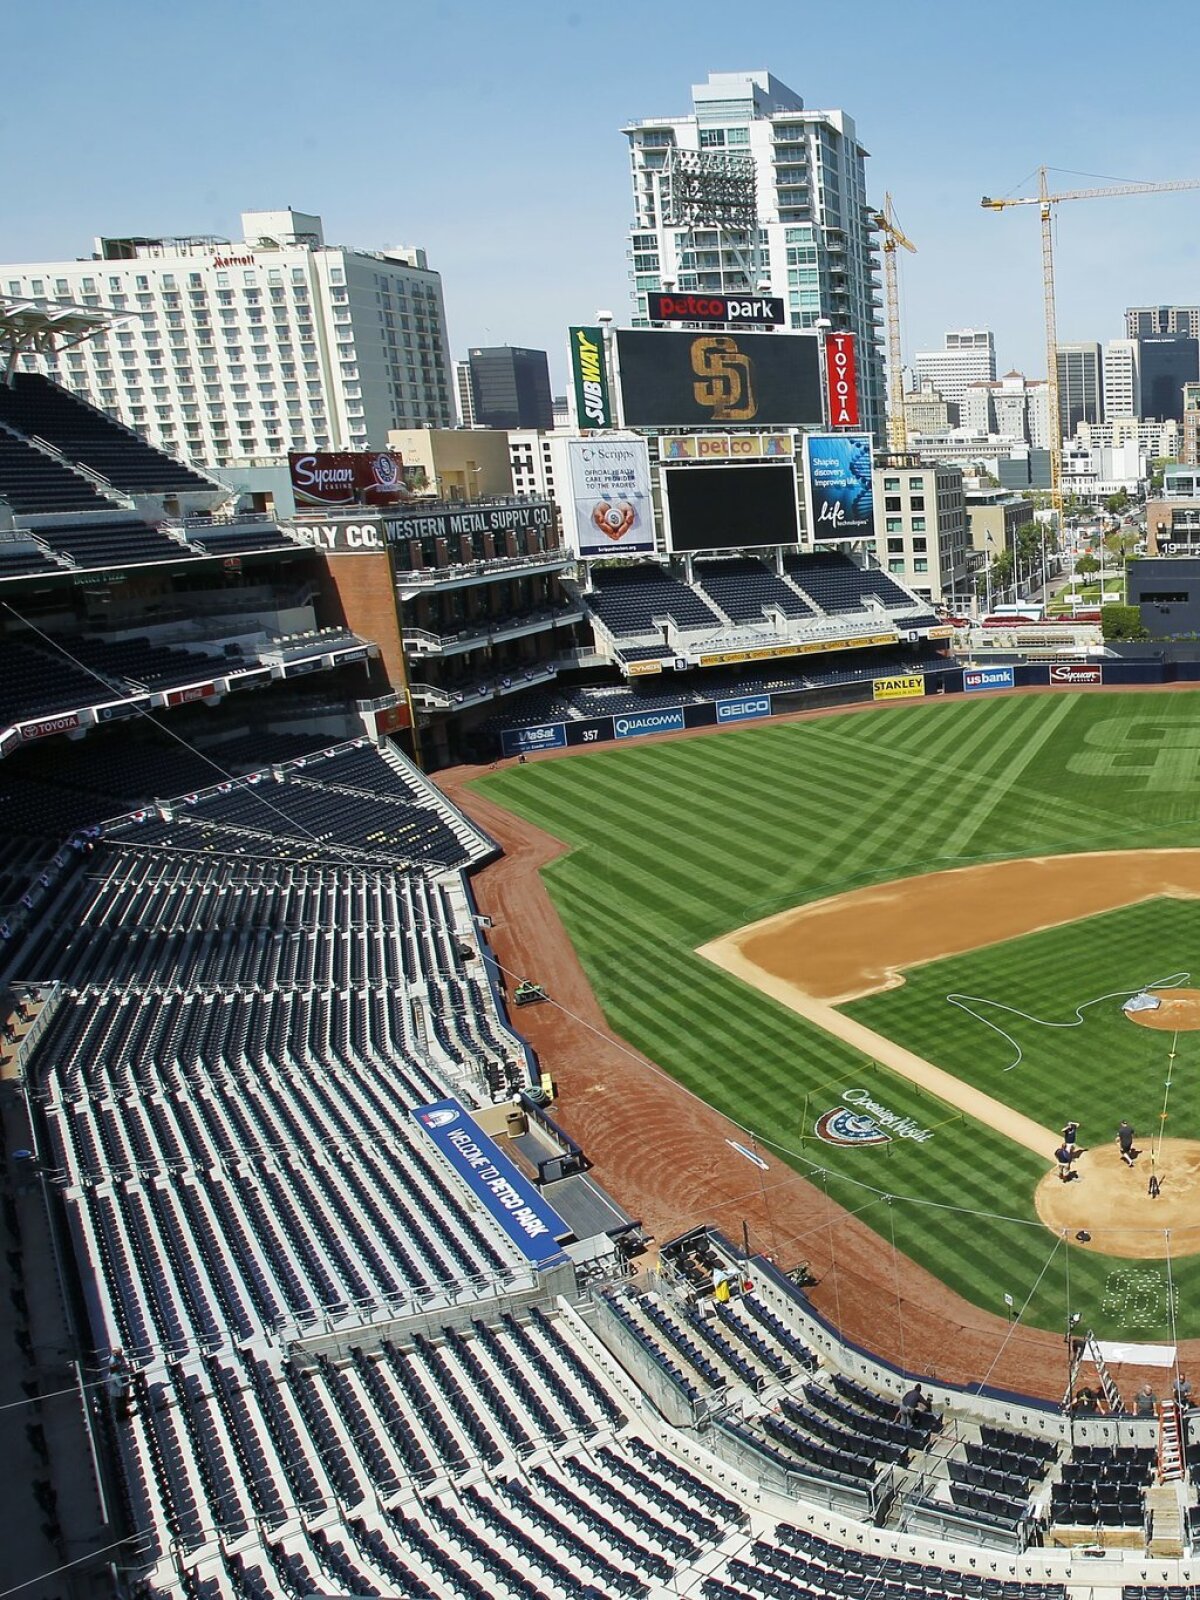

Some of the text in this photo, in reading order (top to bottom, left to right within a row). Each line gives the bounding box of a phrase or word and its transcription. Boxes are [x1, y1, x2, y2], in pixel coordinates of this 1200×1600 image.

[213, 255, 255, 268] Marriott
[659, 297, 774, 321] petco park
[579, 330, 606, 426] SUBWAY
[835, 338, 851, 422] TOYOTA
[598, 448, 634, 460] Scripps
[698, 439, 752, 457] petco
[813, 458, 839, 467] Shaping
[295, 456, 355, 491] Sycuan
[815, 478, 847, 488] Improving
[818, 500, 845, 528] life
[384, 507, 551, 541] WESTERN METAL SUPPLY CO.
[346, 524, 385, 548] CO.
[1161, 542, 1177, 554] 19
[628, 664, 660, 673] CYMER
[1051, 667, 1098, 682] Sycuan
[874, 679, 922, 691] STANLEY
[719, 700, 769, 717] GEICO
[39, 717, 77, 733] TOYOTA
[616, 713, 682, 734] QUALCOMM
[519, 728, 555, 741] ViaSat
[582, 730, 599, 741] 357
[842, 1088, 935, 1143] Opening Night
[446, 1128, 549, 1238] WELCOME TO PETCO PARK
